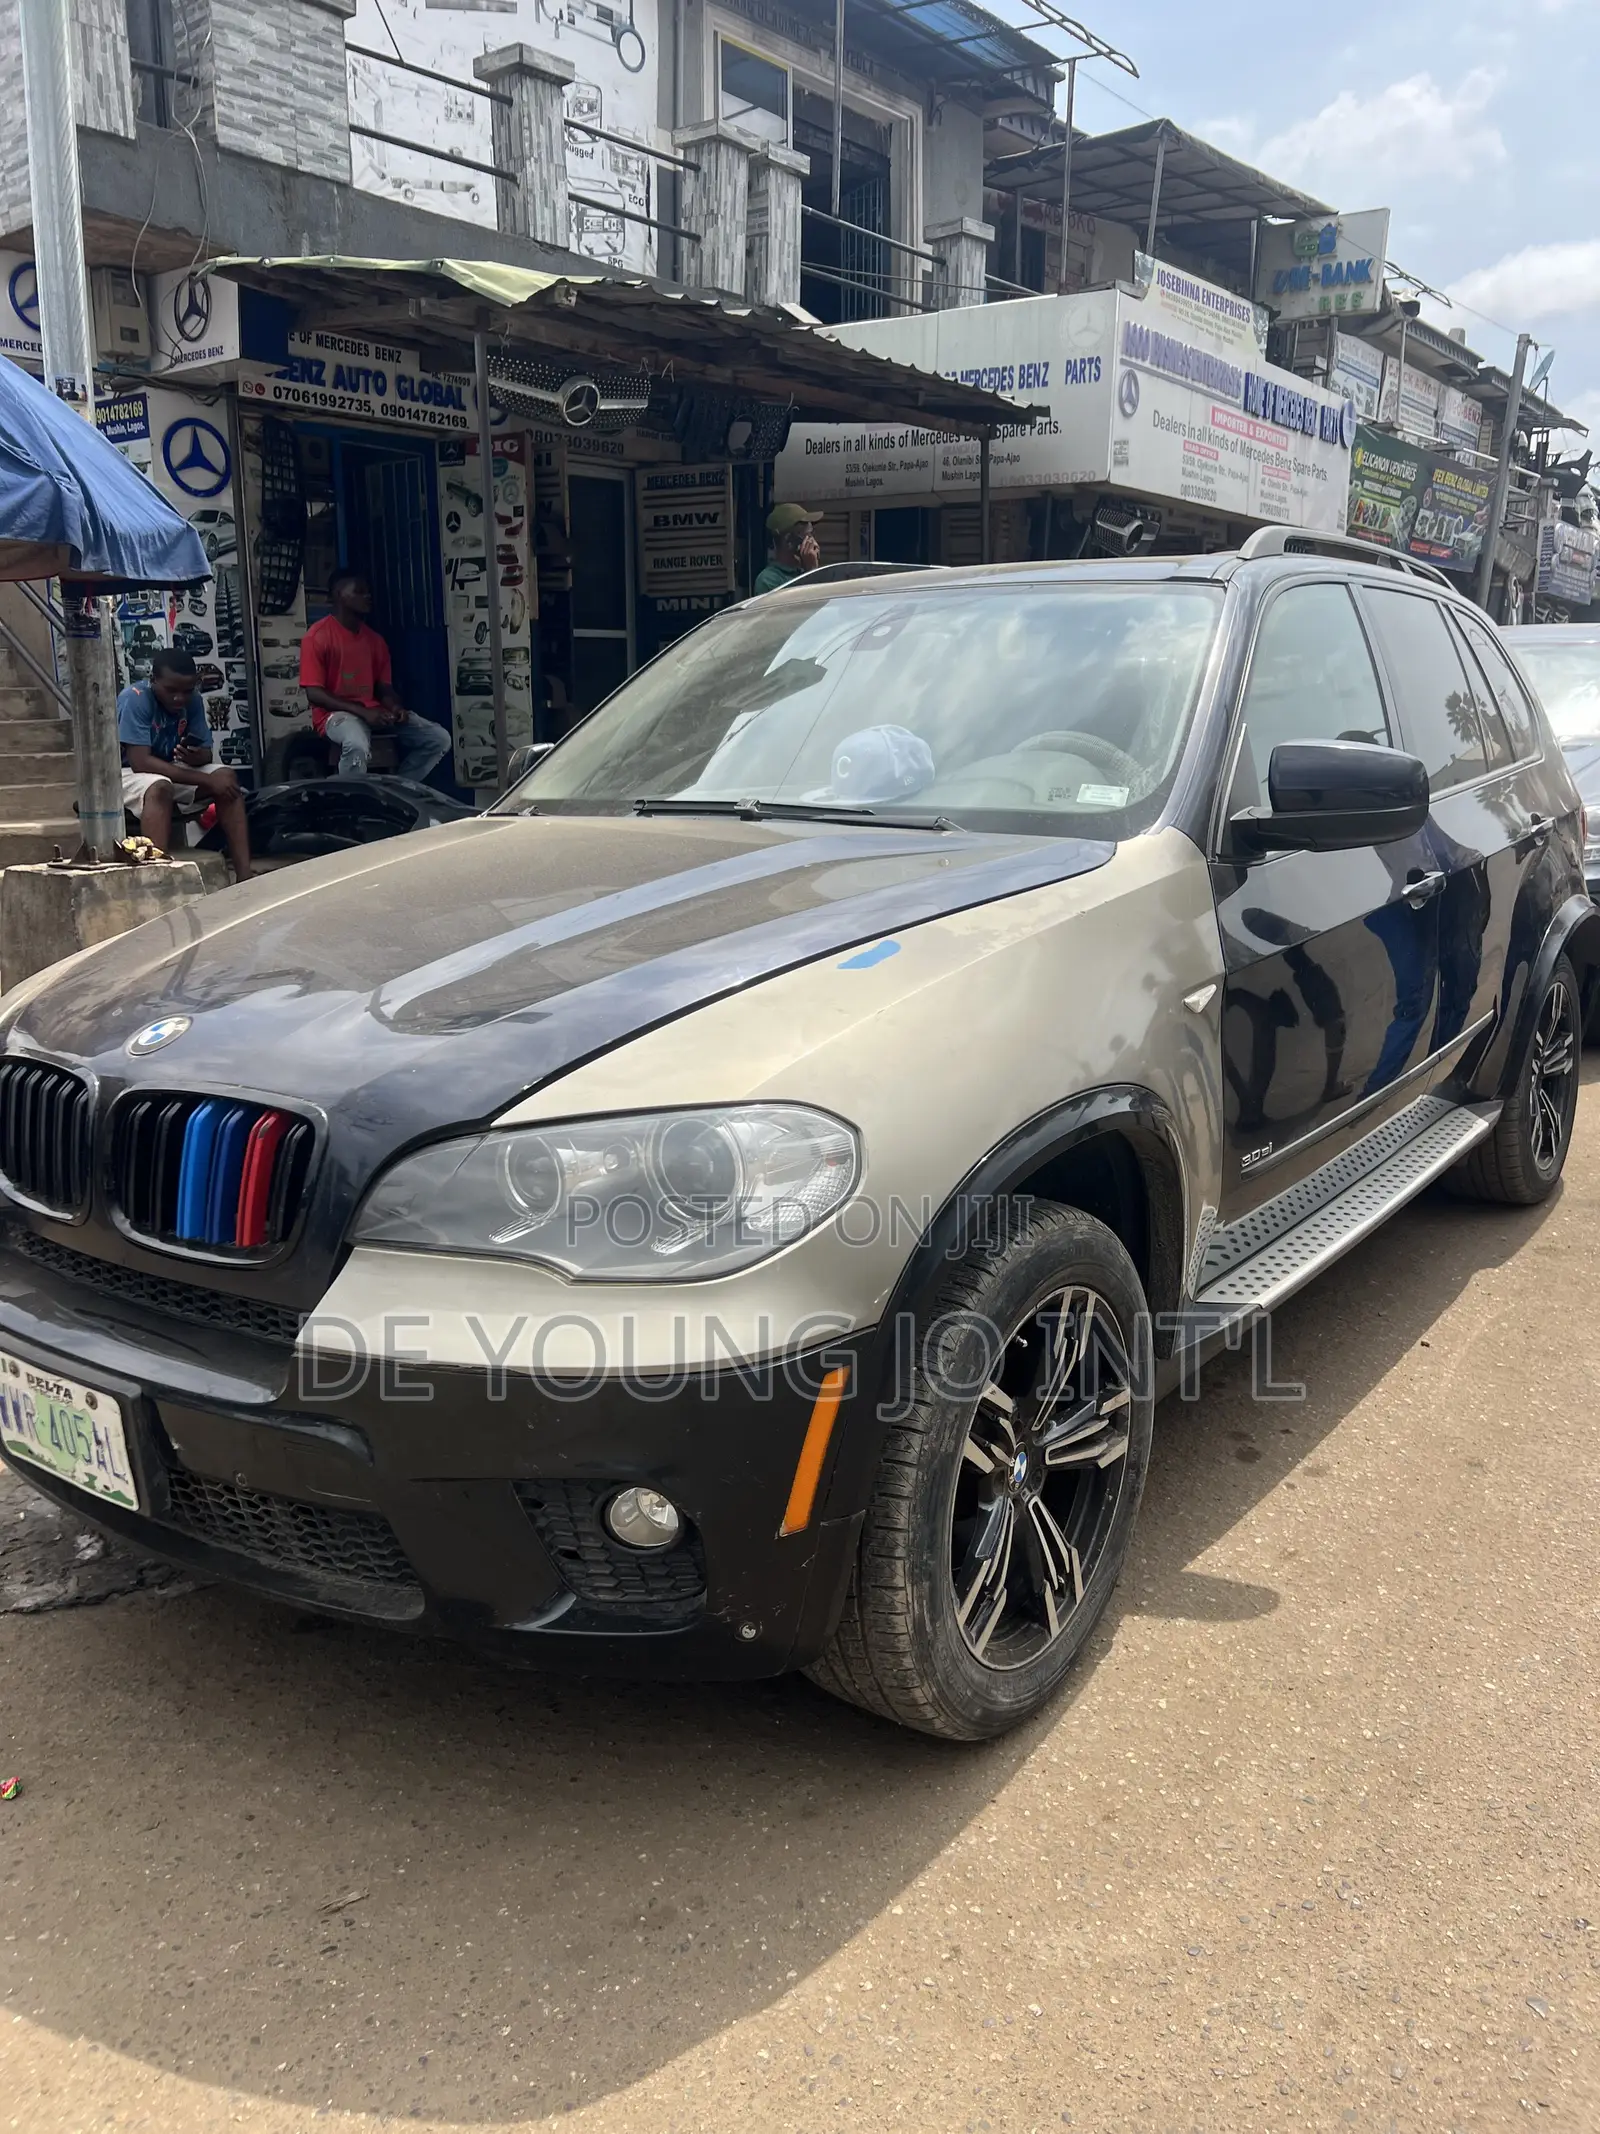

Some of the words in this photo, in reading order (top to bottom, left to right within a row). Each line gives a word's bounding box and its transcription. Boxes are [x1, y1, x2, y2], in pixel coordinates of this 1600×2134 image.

[1202, 288, 1251, 323] ENTERPRISES
[0, 337, 43, 352] MERCED
[175, 349, 206, 363] MERCEDES
[208, 346, 224, 359] BENZ
[316, 333, 370, 358] MERCEDES
[375, 346, 402, 363] BENZ
[1018, 361, 1049, 389] BENZ
[1065, 356, 1101, 385] PARTS
[332, 364, 387, 397] AUTO
[395, 373, 467, 412] GLOBAL
[273, 386, 375, 417] 07061992735,
[805, 436, 841, 455] Dealers
[843, 435, 852, 452] in
[854, 434, 867, 451] all
[868, 431, 896, 450] kinds
[898, 429, 909, 448] of
[911, 426, 961, 446] Mercedes
[1214, 411, 1248, 438] IMPORTER
[1255, 427, 1287, 448] EXPORTER
[1153, 409, 1186, 437] Dealers
[1187, 424, 1197, 441] in
[1197, 426, 1208, 443] all
[1208, 429, 1229, 451] kinds
[1231, 440, 1239, 453] of
[1240, 440, 1274, 466] Mercedes
[1275, 448, 1291, 471] Benz
[1292, 457, 1311, 477] Spare
[1311, 463, 1328, 482] Parts.
[990, 453, 1021, 467] Papa-Ajao
[1389, 461, 1418, 482] VENTURES
[646, 472, 696, 489] MERCEDES
[965, 470, 980, 482] Lago
[653, 512, 720, 528] BMW
[653, 556, 687, 569] RANGE
[690, 554, 723, 567] ROVER
[657, 597, 721, 611] MINI
[837, 755, 851, 778] C
[26, 1371, 73, 1400] DELTA
